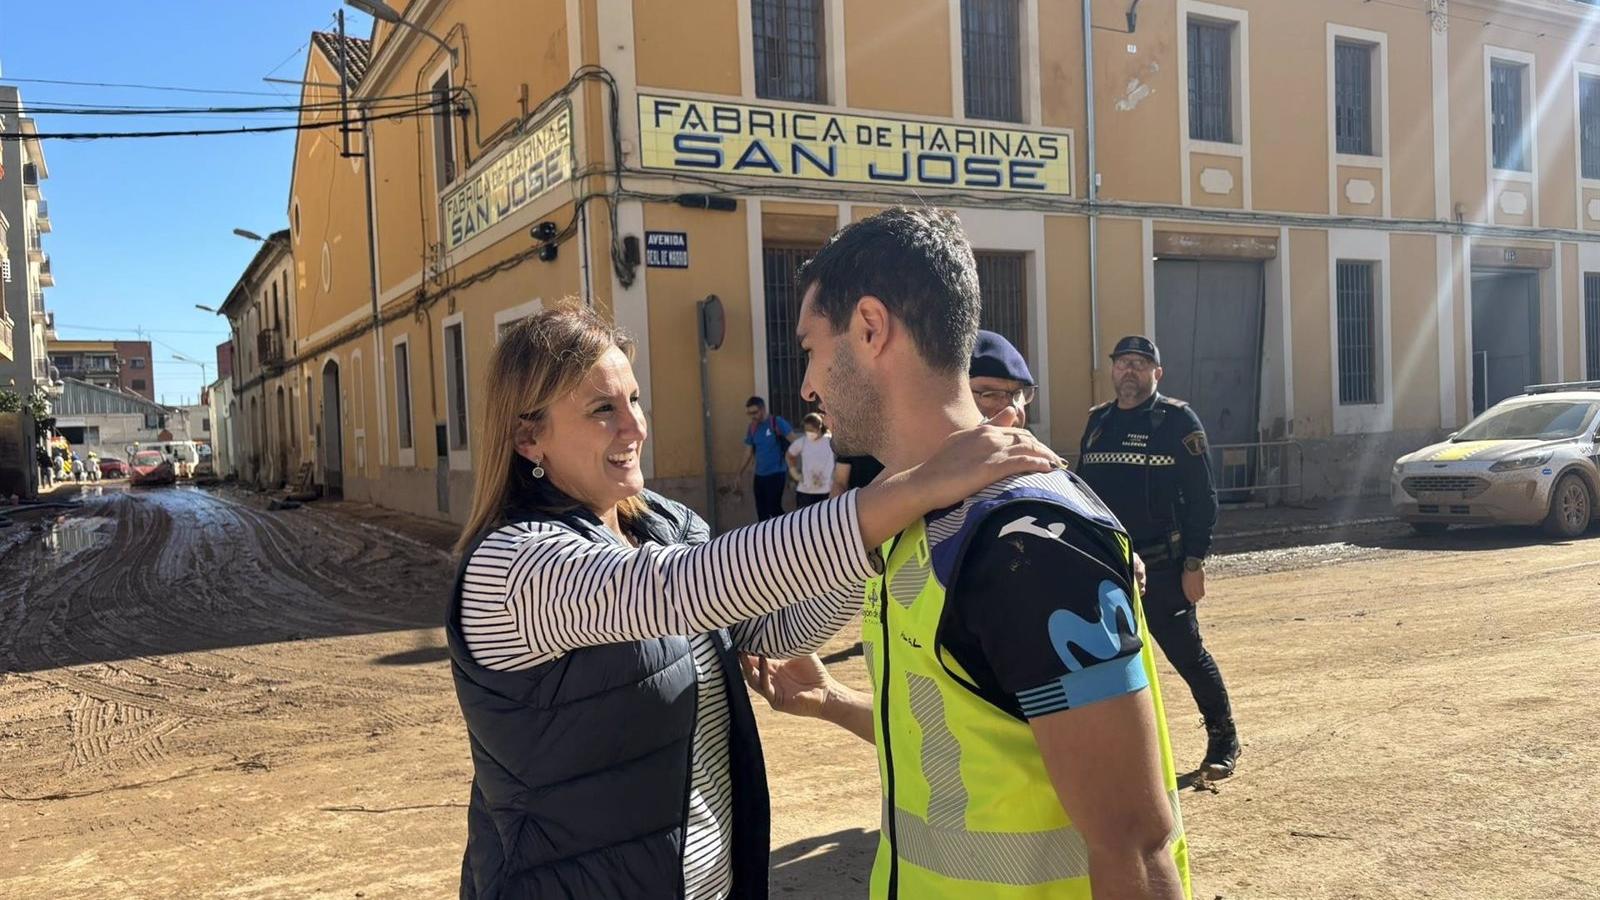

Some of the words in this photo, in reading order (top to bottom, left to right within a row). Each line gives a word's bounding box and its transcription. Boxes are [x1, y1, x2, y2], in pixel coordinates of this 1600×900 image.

[654, 99, 846, 143] FABRICA
[856, 124, 892, 147] DE
[902, 124, 1059, 160] HARINAS
[448, 173, 491, 216] FABRICA
[505, 113, 569, 179] HARINAS
[673, 133, 838, 177] SAN
[869, 151, 1048, 190] JOSE
[452, 196, 491, 245] SAN
[497, 148, 564, 216] JOSE
[647, 234, 685, 246] AVENIDA
